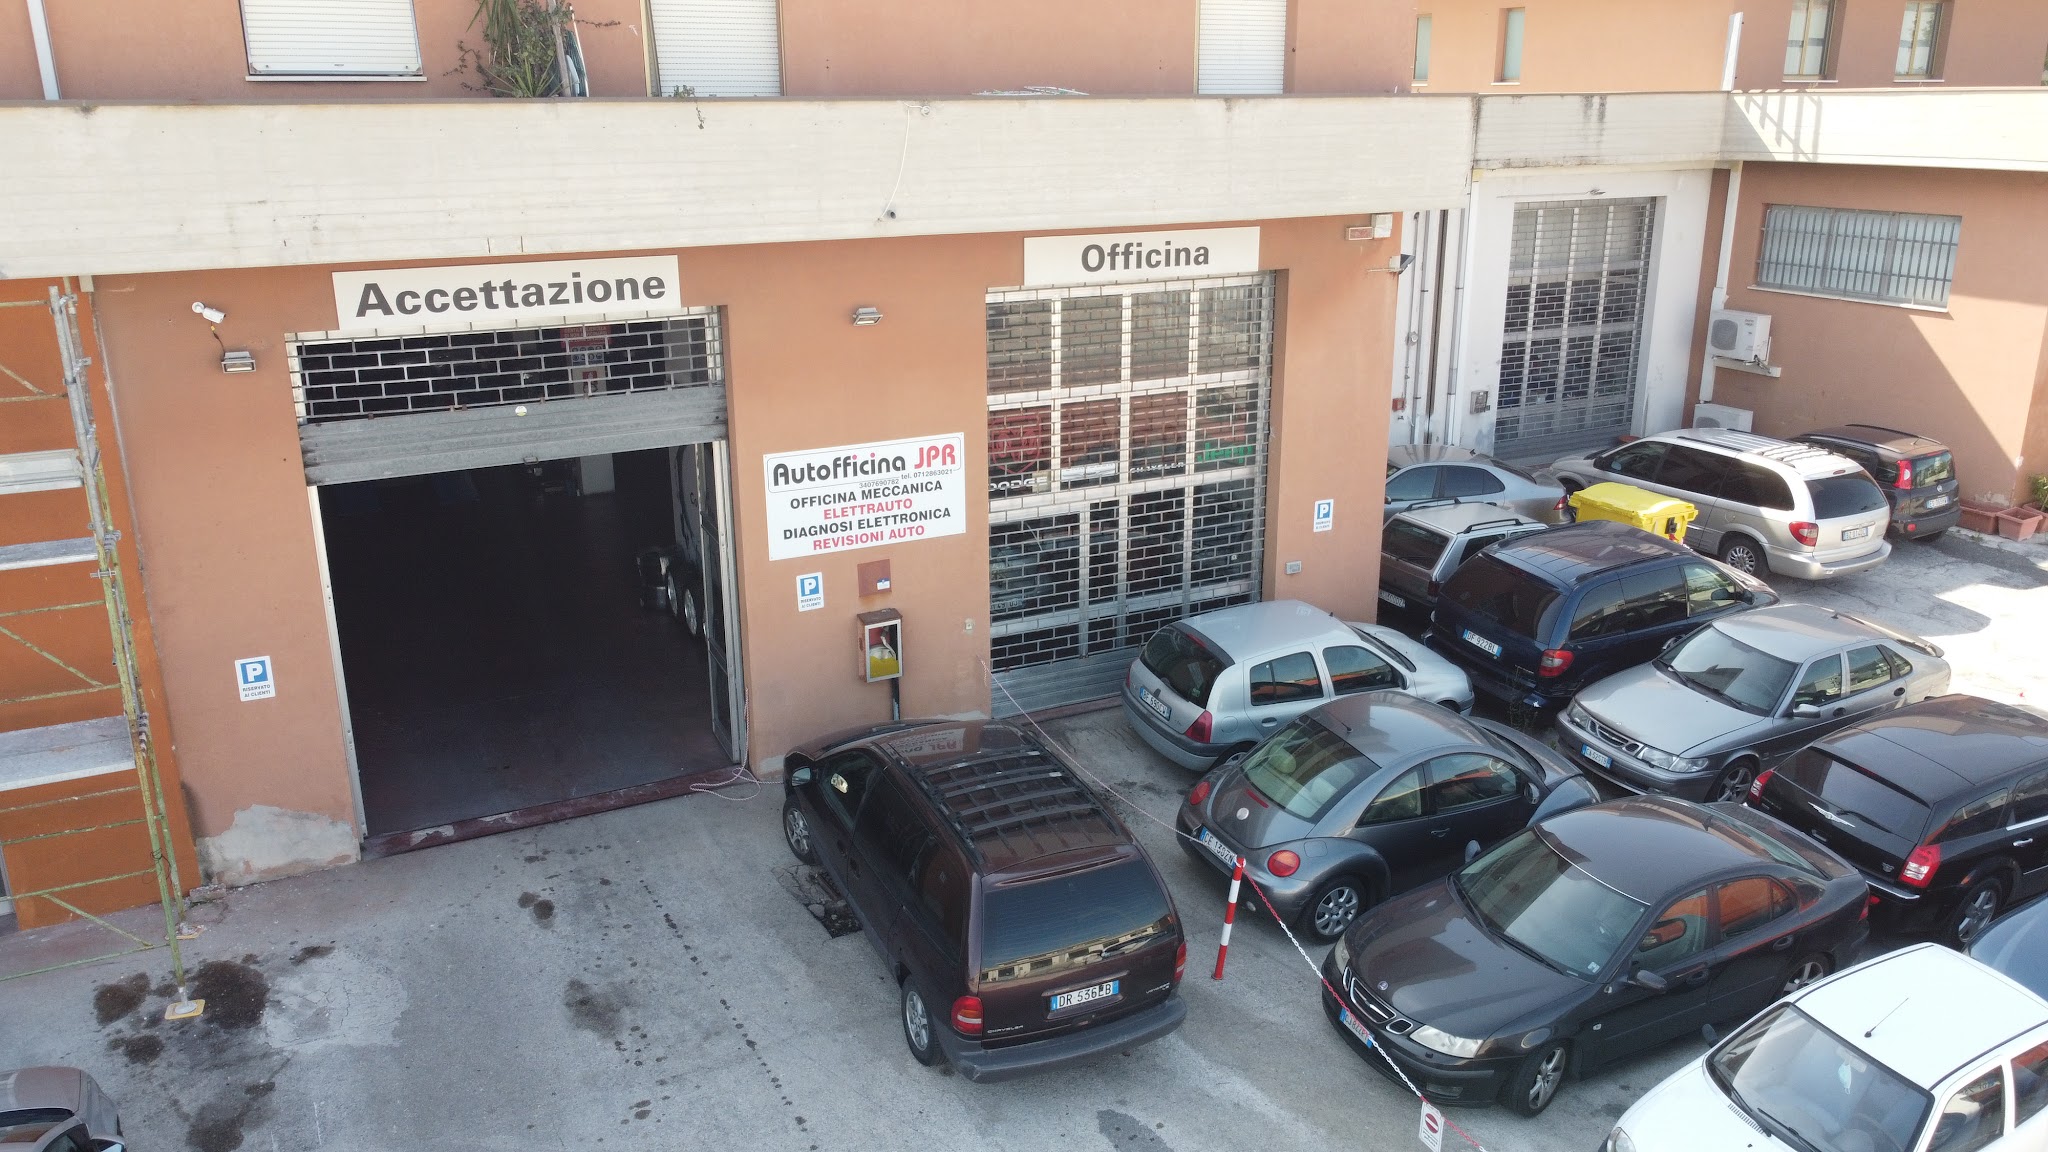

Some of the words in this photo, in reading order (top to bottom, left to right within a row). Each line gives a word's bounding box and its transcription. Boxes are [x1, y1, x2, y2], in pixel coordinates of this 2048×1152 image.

[1081, 240, 1209, 273] Officina
[355, 271, 666, 318] Accettazione
[773, 452, 906, 487] Autofficina
[914, 443, 956, 470] JPR
[901, 472, 912, 480] tel.
[913, 469, 953, 479] 0712863021
[790, 491, 857, 509] OFFICINA
[861, 480, 943, 501] MECCANICA
[823, 498, 913, 520] ELETTRAUTO
[1320, 504, 1329, 518] P
[783, 520, 853, 540] DIAGNOSI
[857, 507, 951, 530] ELETTRONICA
[813, 530, 884, 551] REVISIONI
[888, 525, 925, 540] AUTO
[804, 578, 816, 595] P
[246, 662, 263, 682] P
[242, 684, 271, 692] RISERVATO
[1059, 993, 1073, 1008] DR
